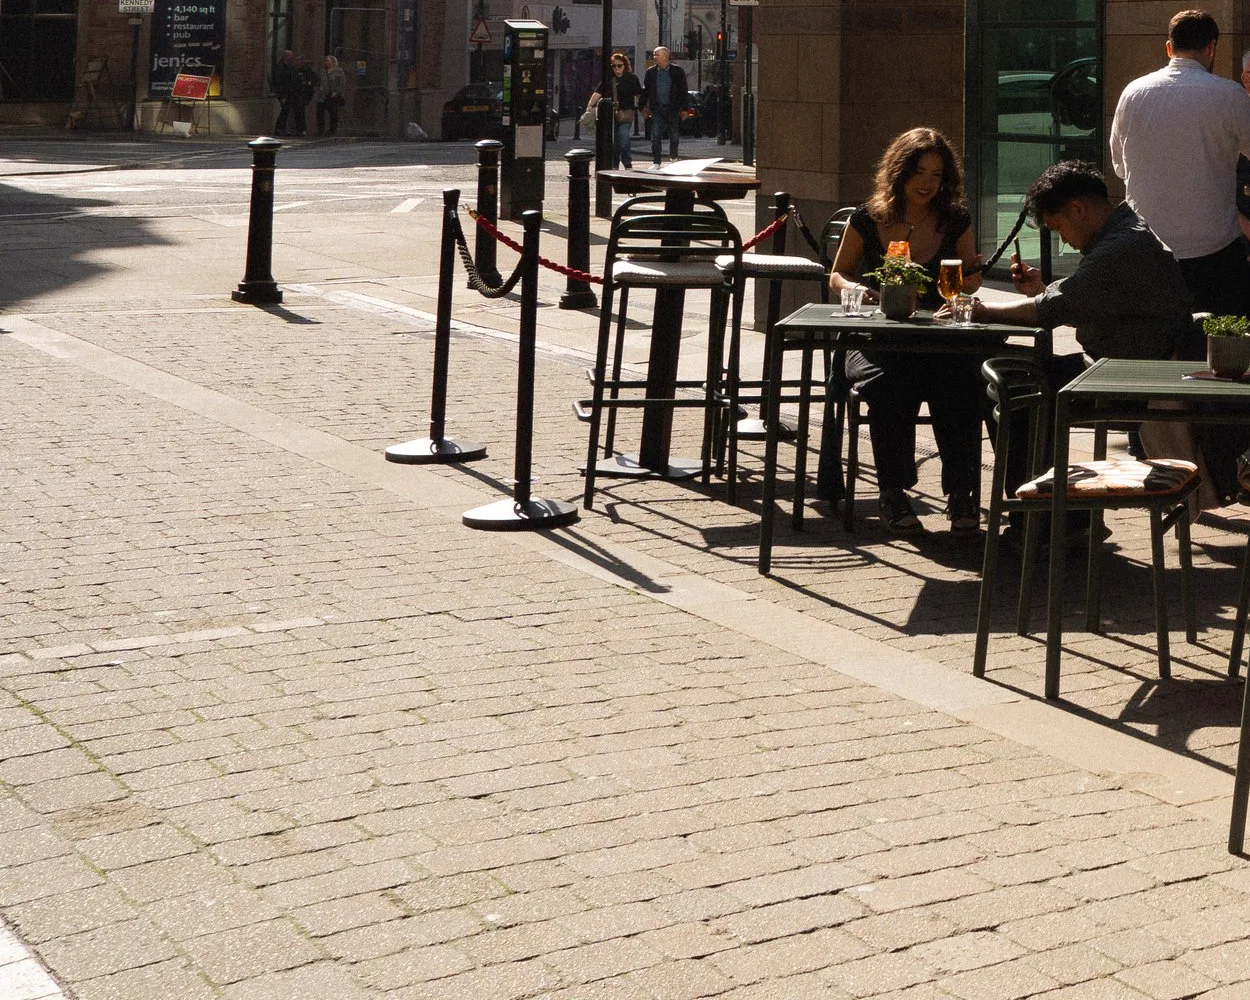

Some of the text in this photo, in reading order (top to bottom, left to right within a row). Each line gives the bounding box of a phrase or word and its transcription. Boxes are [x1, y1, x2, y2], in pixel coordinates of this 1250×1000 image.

[174, 5, 198, 14] 4,140
[209, 5, 215, 13] ft
[172, 31, 191, 39] pub
[152, 53, 201, 71] jenics
